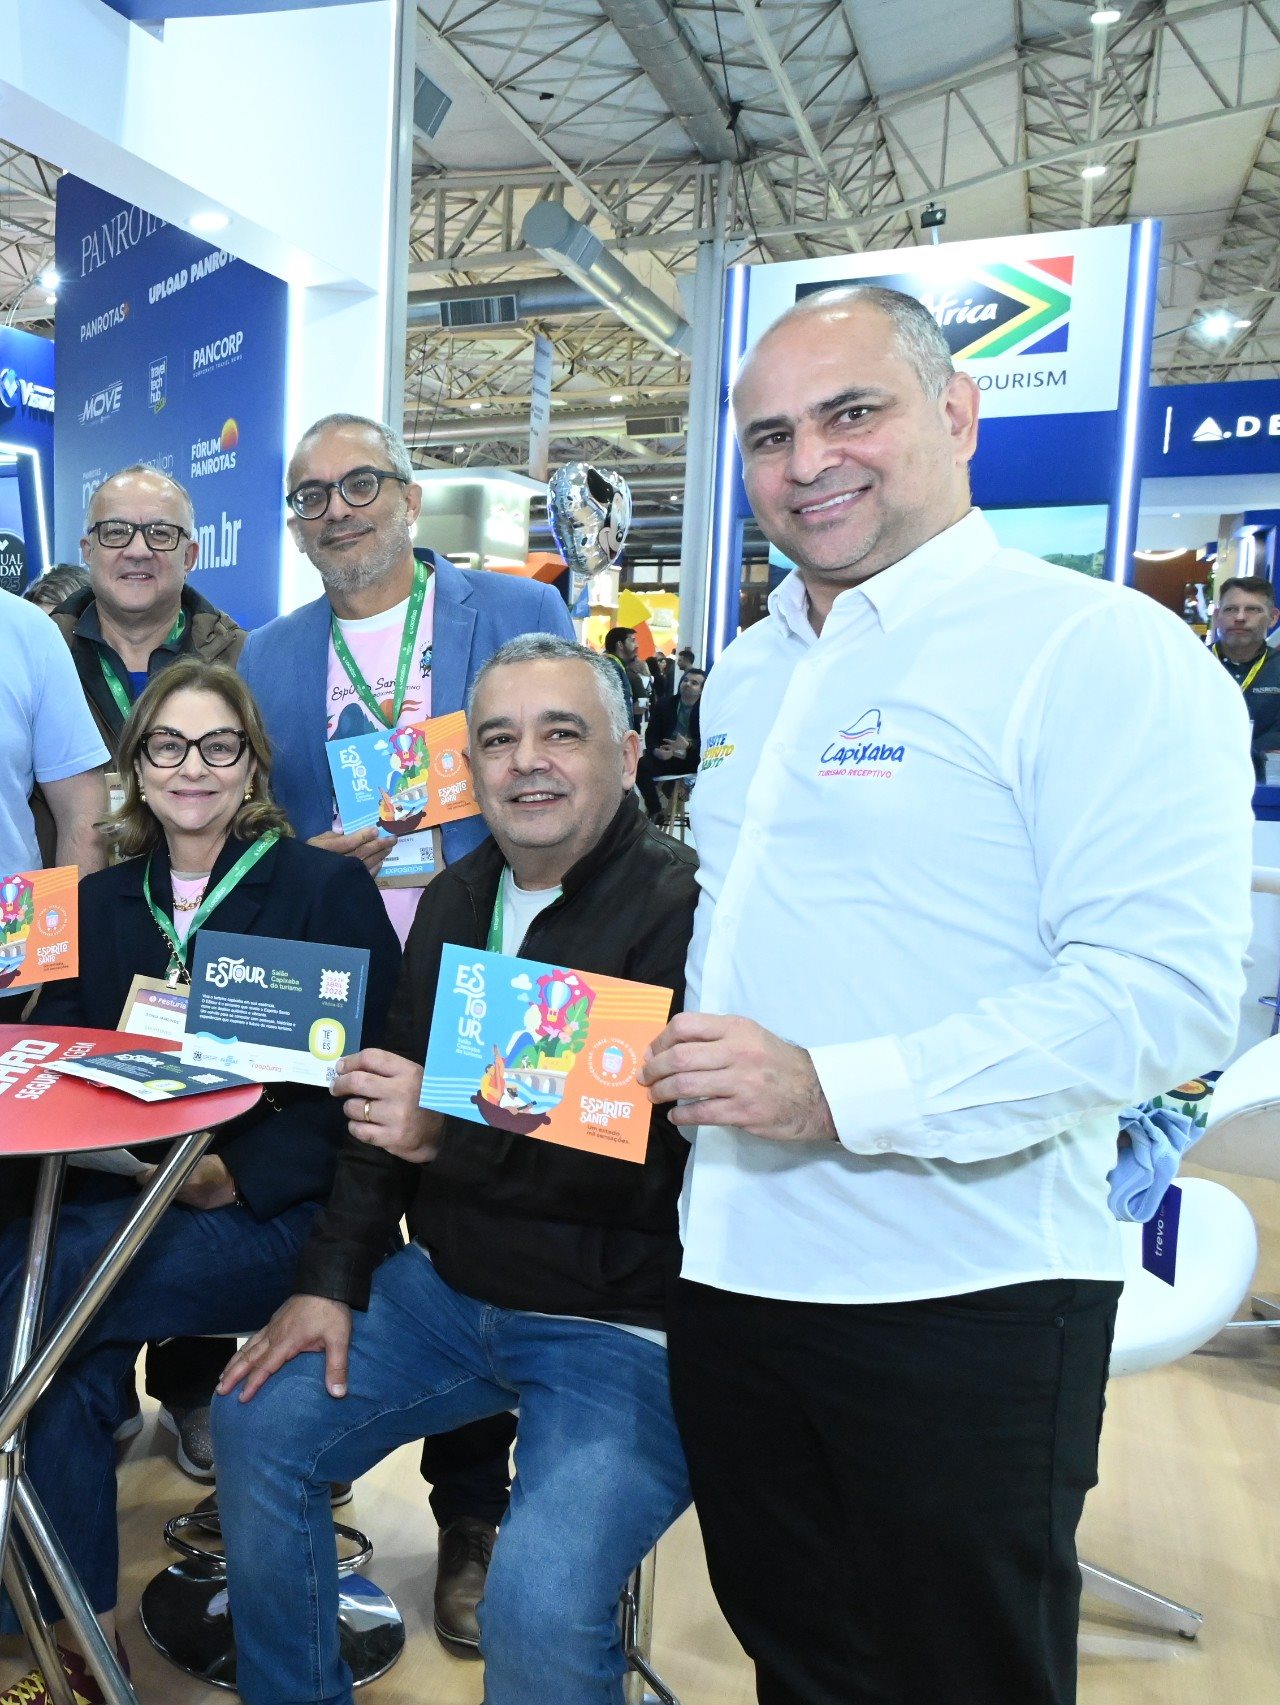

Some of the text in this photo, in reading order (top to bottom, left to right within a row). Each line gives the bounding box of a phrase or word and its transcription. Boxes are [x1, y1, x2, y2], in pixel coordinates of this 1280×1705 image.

[148, 269, 189, 305] UPLOAD
[80, 303, 126, 343] PANROTAS
[192, 330, 244, 371] PANCORP
[150, 376, 163, 392] tech
[971, 369, 1067, 391] OURISM
[82, 385, 123, 422] MOVE
[191, 436, 222, 461] FÓRUM
[190, 451, 237, 479] PANROTAS
[820, 742, 906, 766] Capixaba
[817, 768, 892, 778] TURISMO RECEPTIVO
[270, 975, 300, 986] Capixaba
[271, 969, 289, 977] Salão
[325, 981, 343, 989] ABRIL
[455, 962, 486, 994] ES
[279, 983, 303, 993] turismo
[324, 986, 343, 996] 2026
[452, 987, 487, 1020] TO
[458, 1016, 485, 1046] UR
[322, 1042, 331, 1051] ES
[579, 1111, 612, 1127] SANTO
[580, 1095, 635, 1119] ESPÍRITO
[586, 1130, 596, 1138] mil
[1154, 1219, 1165, 1257] trevo
